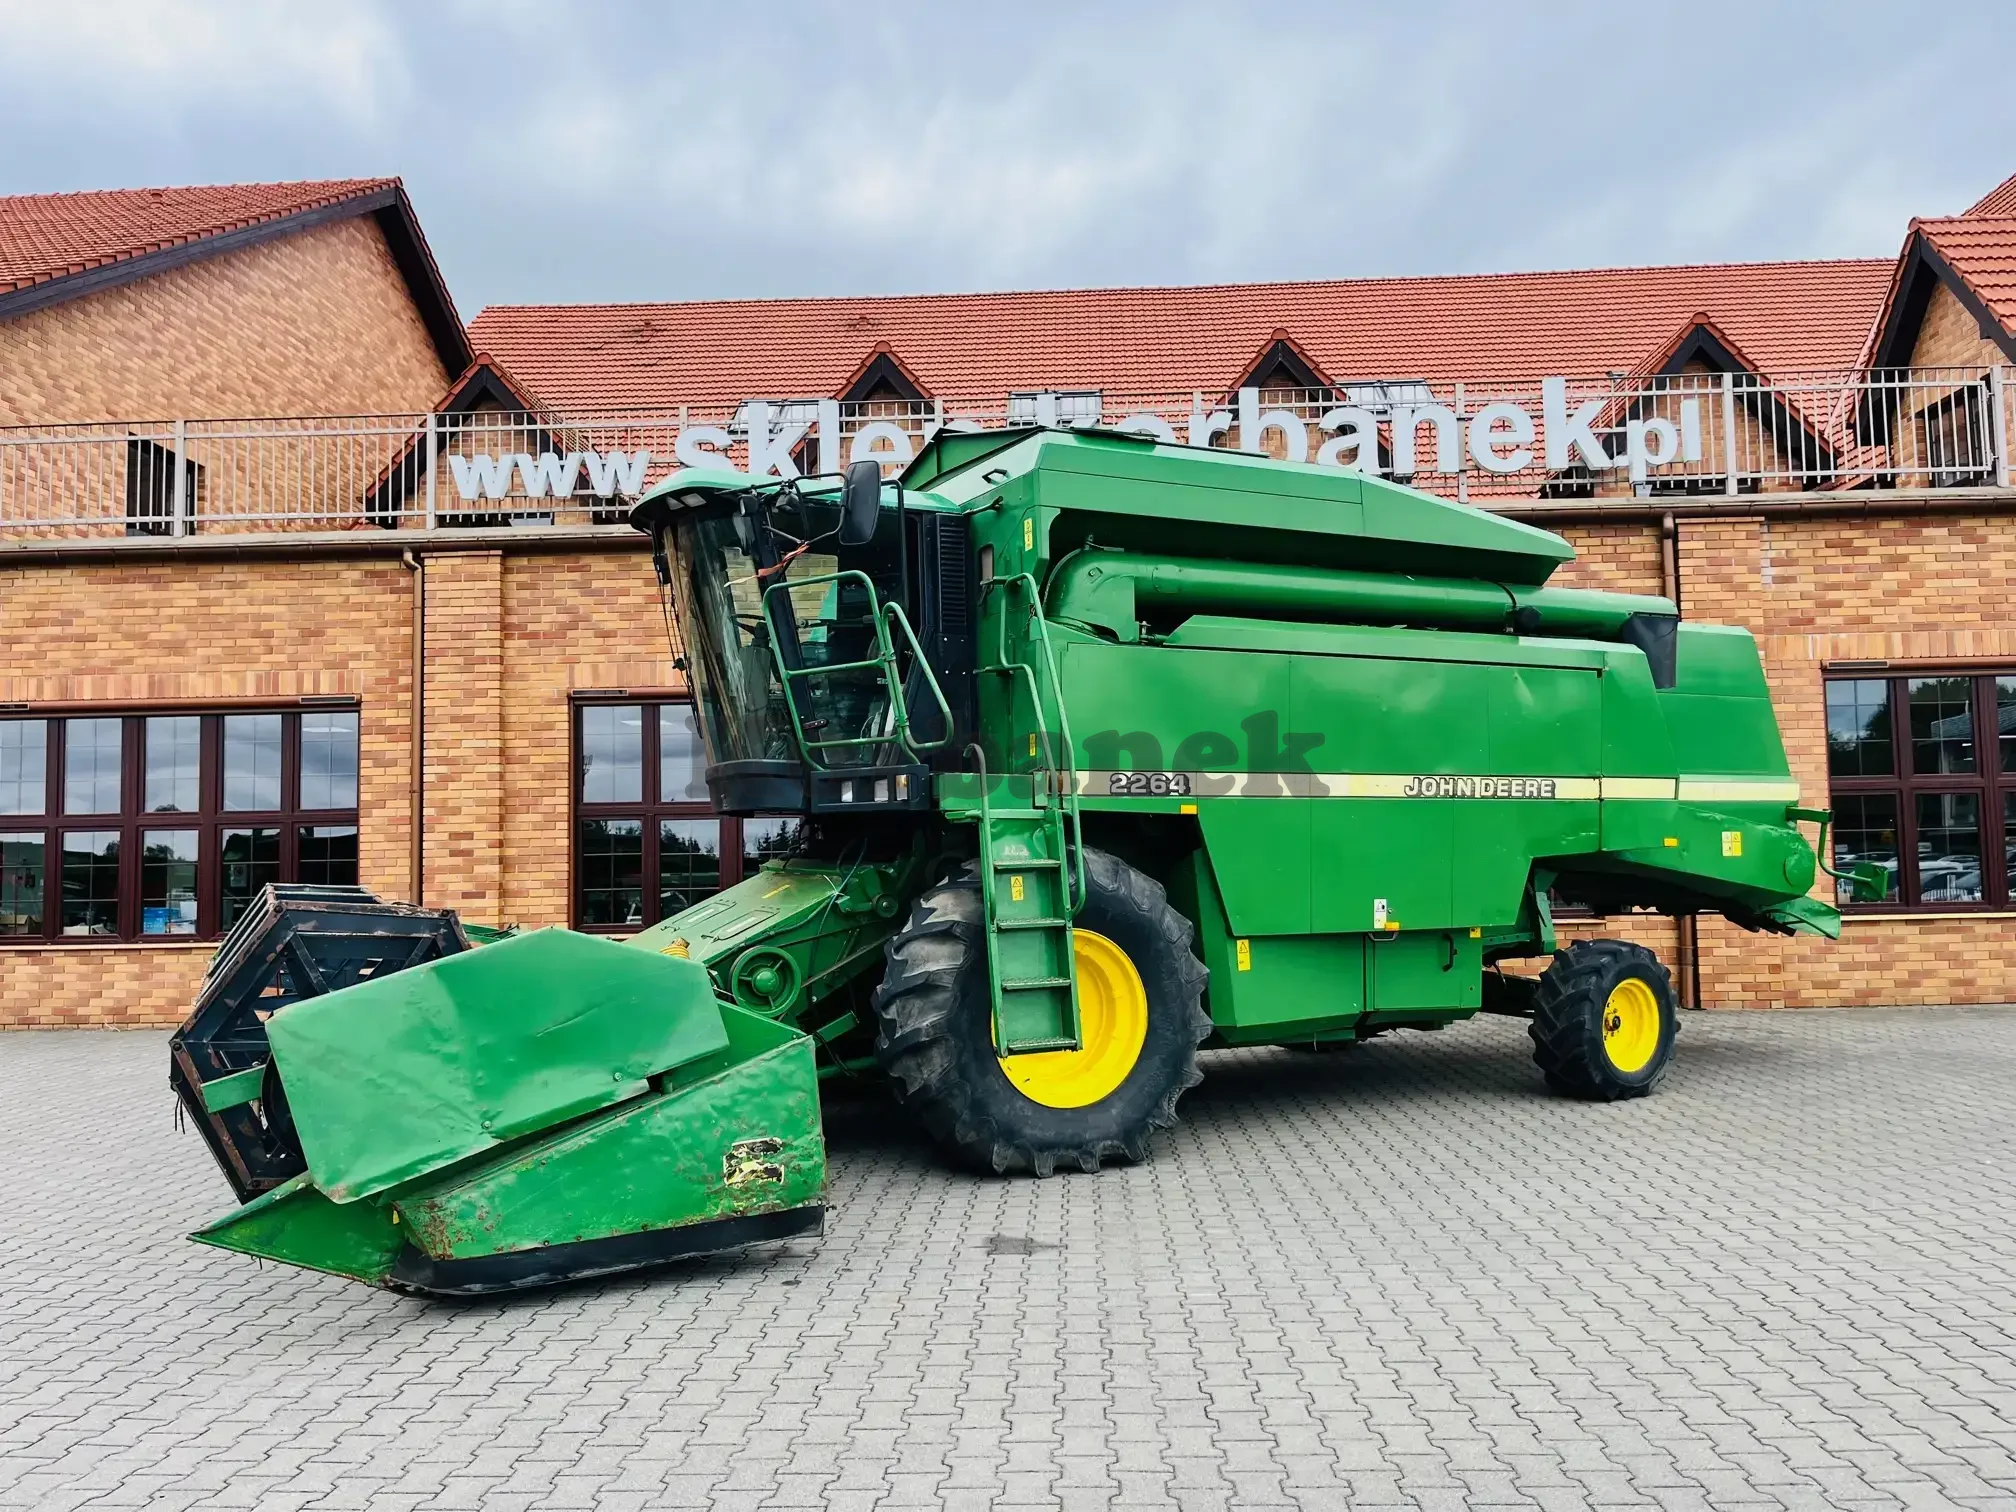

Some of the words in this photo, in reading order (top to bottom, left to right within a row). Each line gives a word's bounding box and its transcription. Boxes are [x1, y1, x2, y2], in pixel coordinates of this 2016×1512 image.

[1110, 772, 1191, 796] 2264
[1403, 776, 1475, 798] JOHN
[1479, 778, 1556, 799] DEERE
